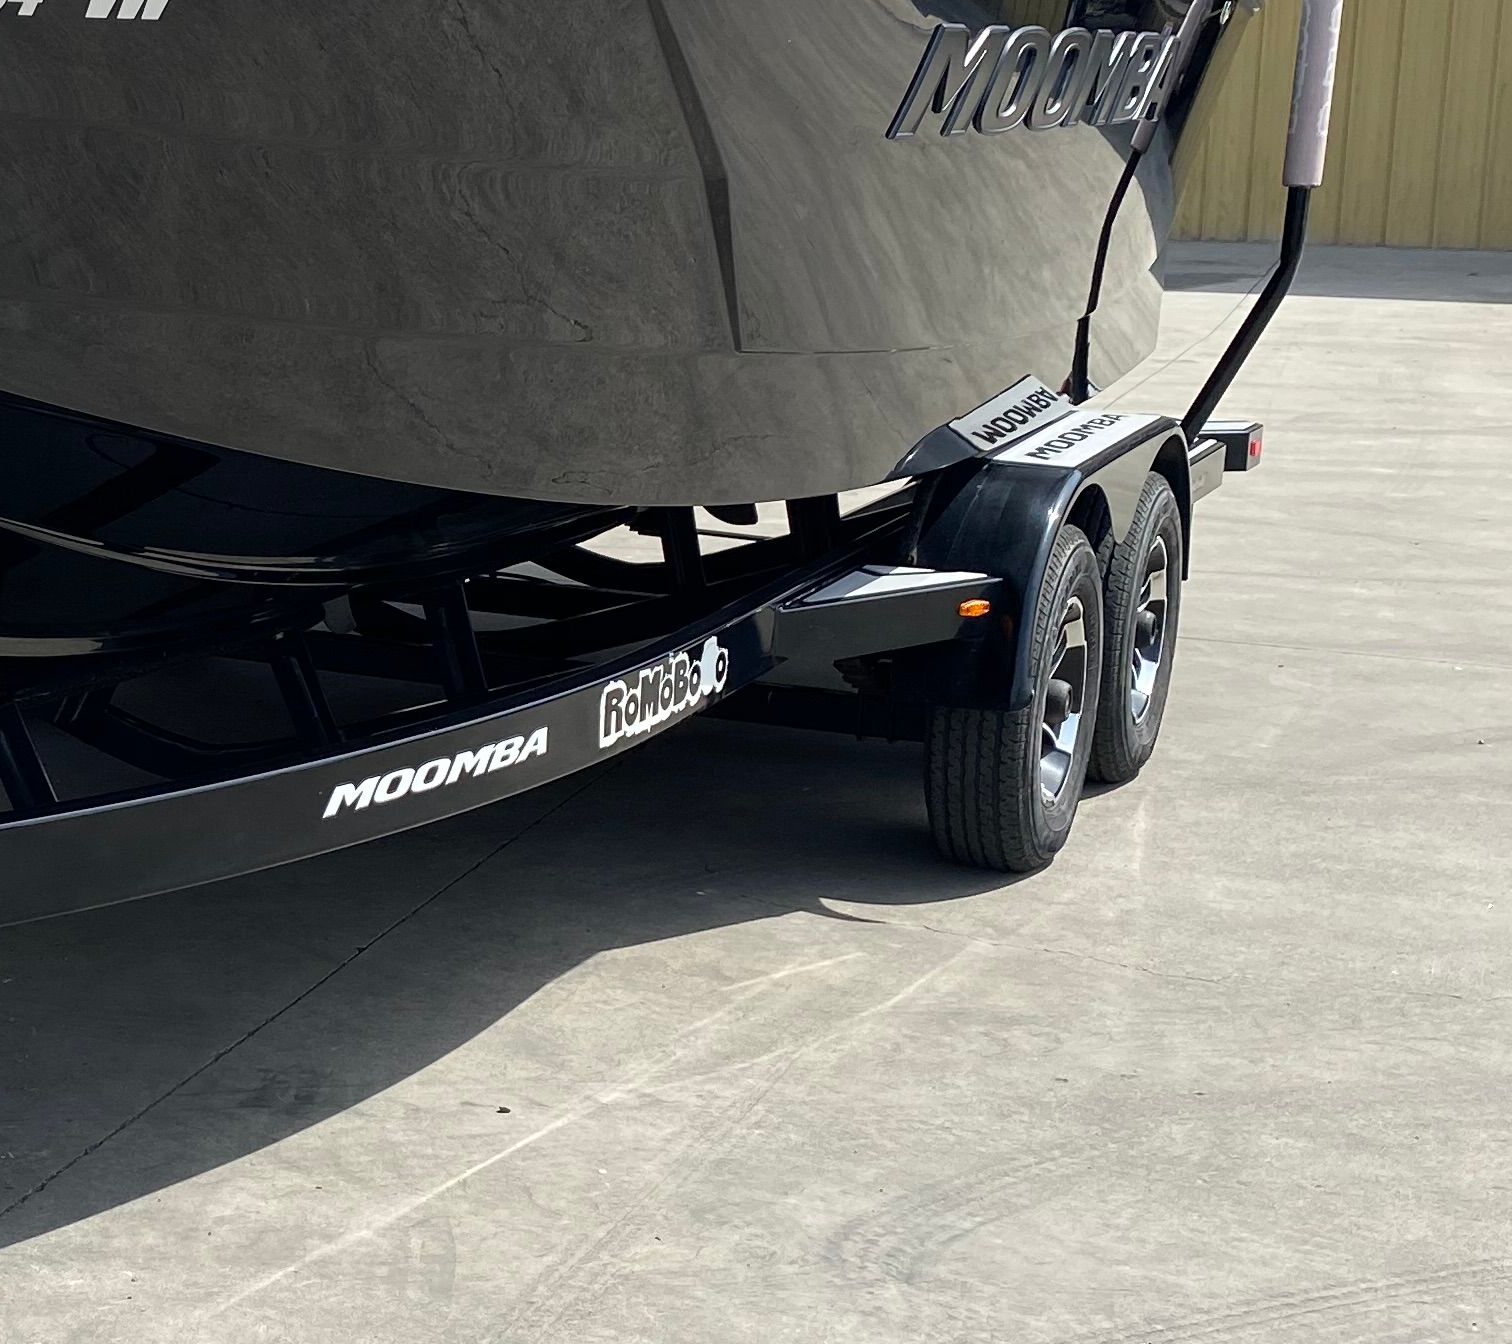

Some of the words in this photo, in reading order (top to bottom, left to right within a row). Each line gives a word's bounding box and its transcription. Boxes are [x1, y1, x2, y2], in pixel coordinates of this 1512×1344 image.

[885, 22, 1180, 140] MOOMBA
[1025, 413, 1127, 460] MOOMBA
[322, 726, 548, 818] MOOMBA
